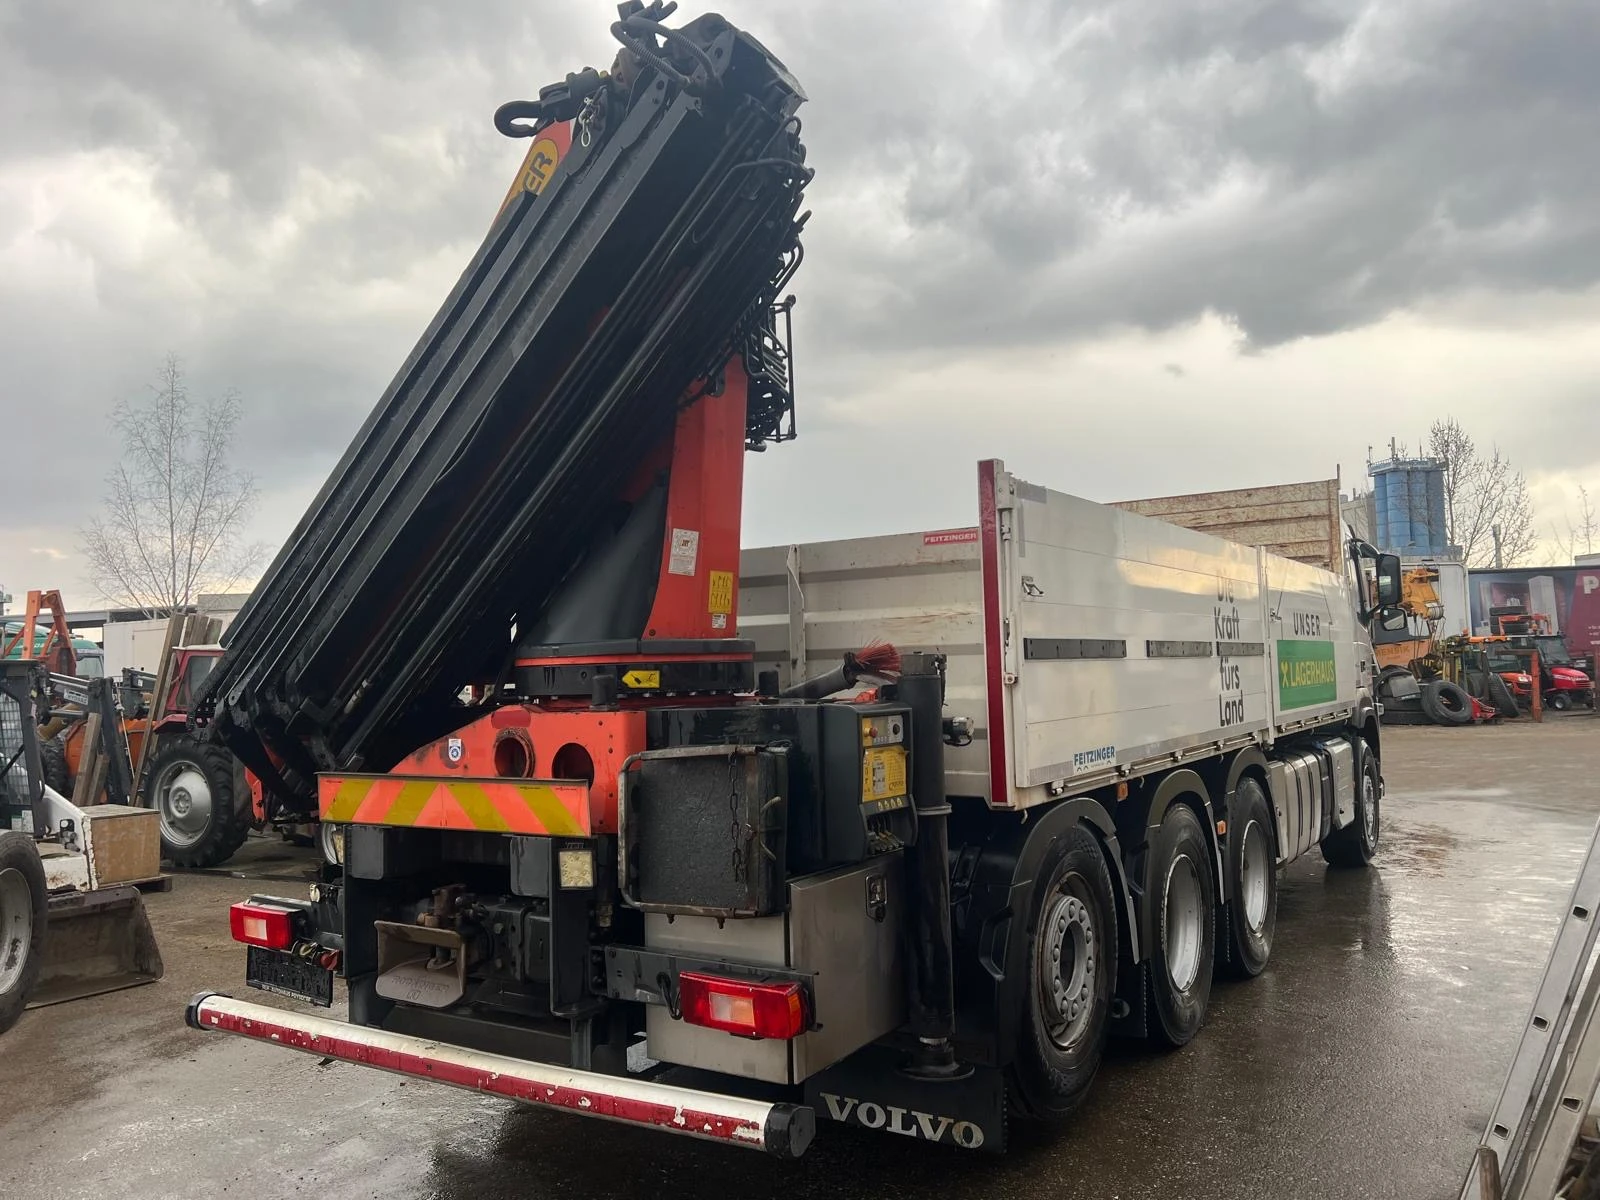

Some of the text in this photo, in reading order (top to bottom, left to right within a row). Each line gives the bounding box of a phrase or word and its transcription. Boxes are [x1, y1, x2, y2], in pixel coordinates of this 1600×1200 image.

[924, 532, 977, 544] FEITZINGER
[1214, 606, 1240, 640] Kraft
[1293, 612, 1321, 636] UNSER
[1219, 656, 1240, 690] fürs
[1289, 660, 1335, 687] LAGERHAUS
[1219, 690, 1245, 727] Land
[1074, 746, 1115, 766] FEITZINGER
[820, 1092, 984, 1149] VOLVO
